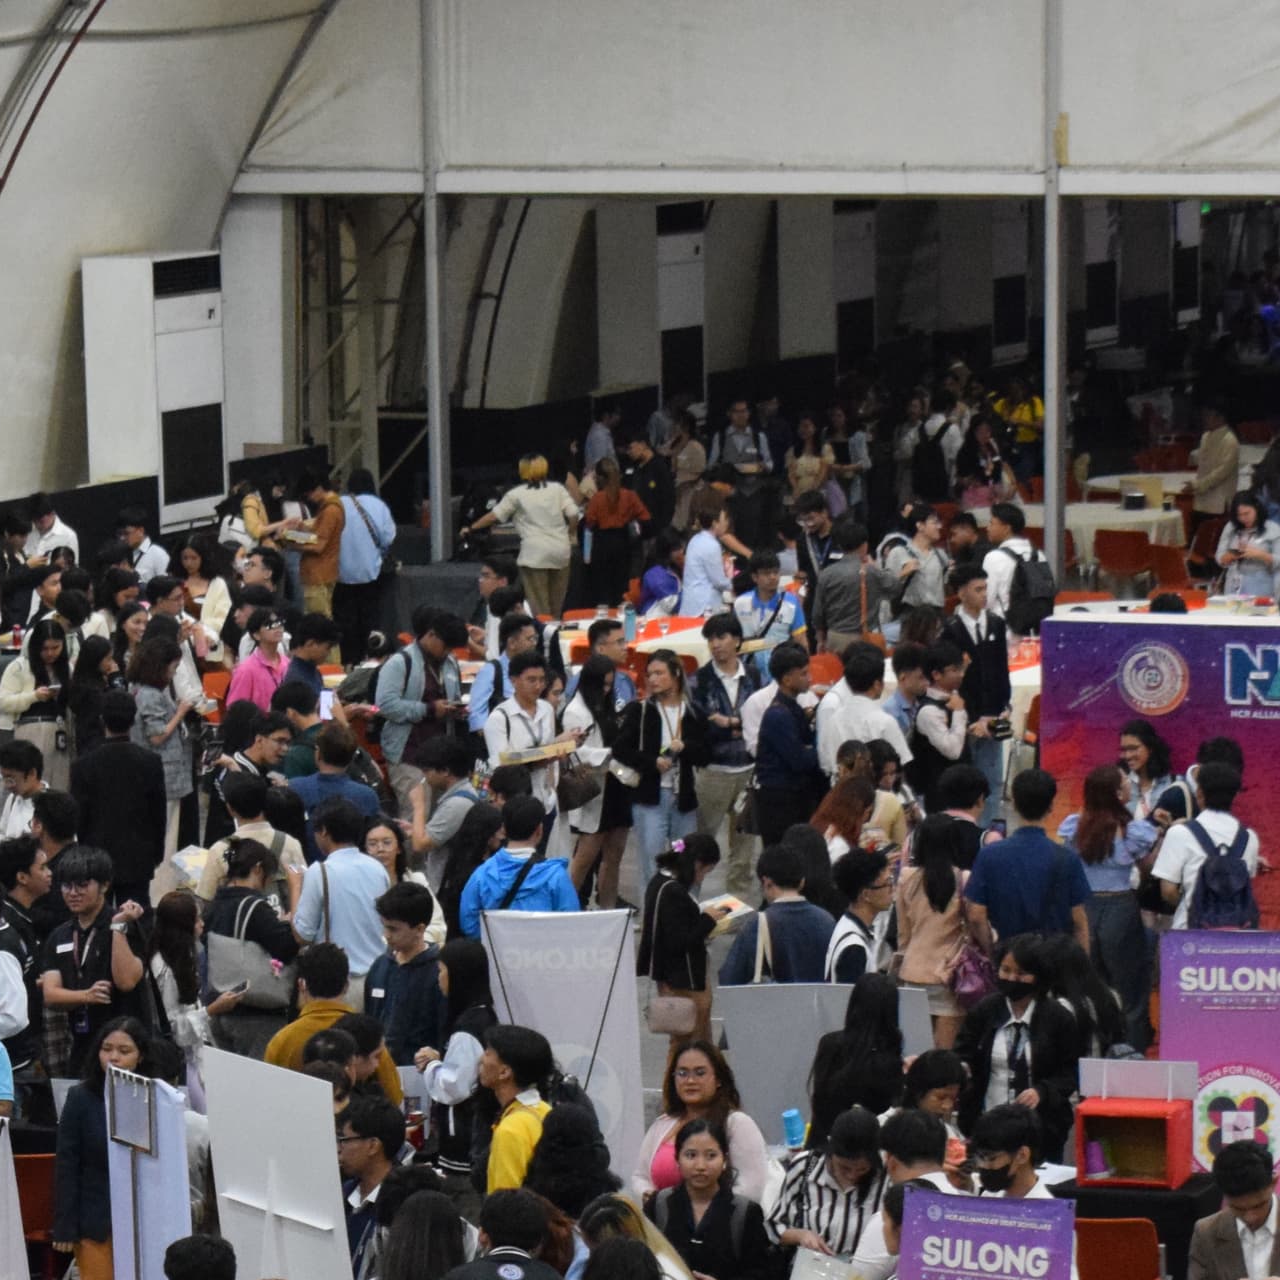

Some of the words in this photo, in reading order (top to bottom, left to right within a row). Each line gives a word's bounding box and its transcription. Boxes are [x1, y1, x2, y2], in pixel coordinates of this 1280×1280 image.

[1231, 710, 1250, 719] NCR
[1223, 1066, 1244, 1075] FOR
[922, 1235, 1049, 1277] SULONG
